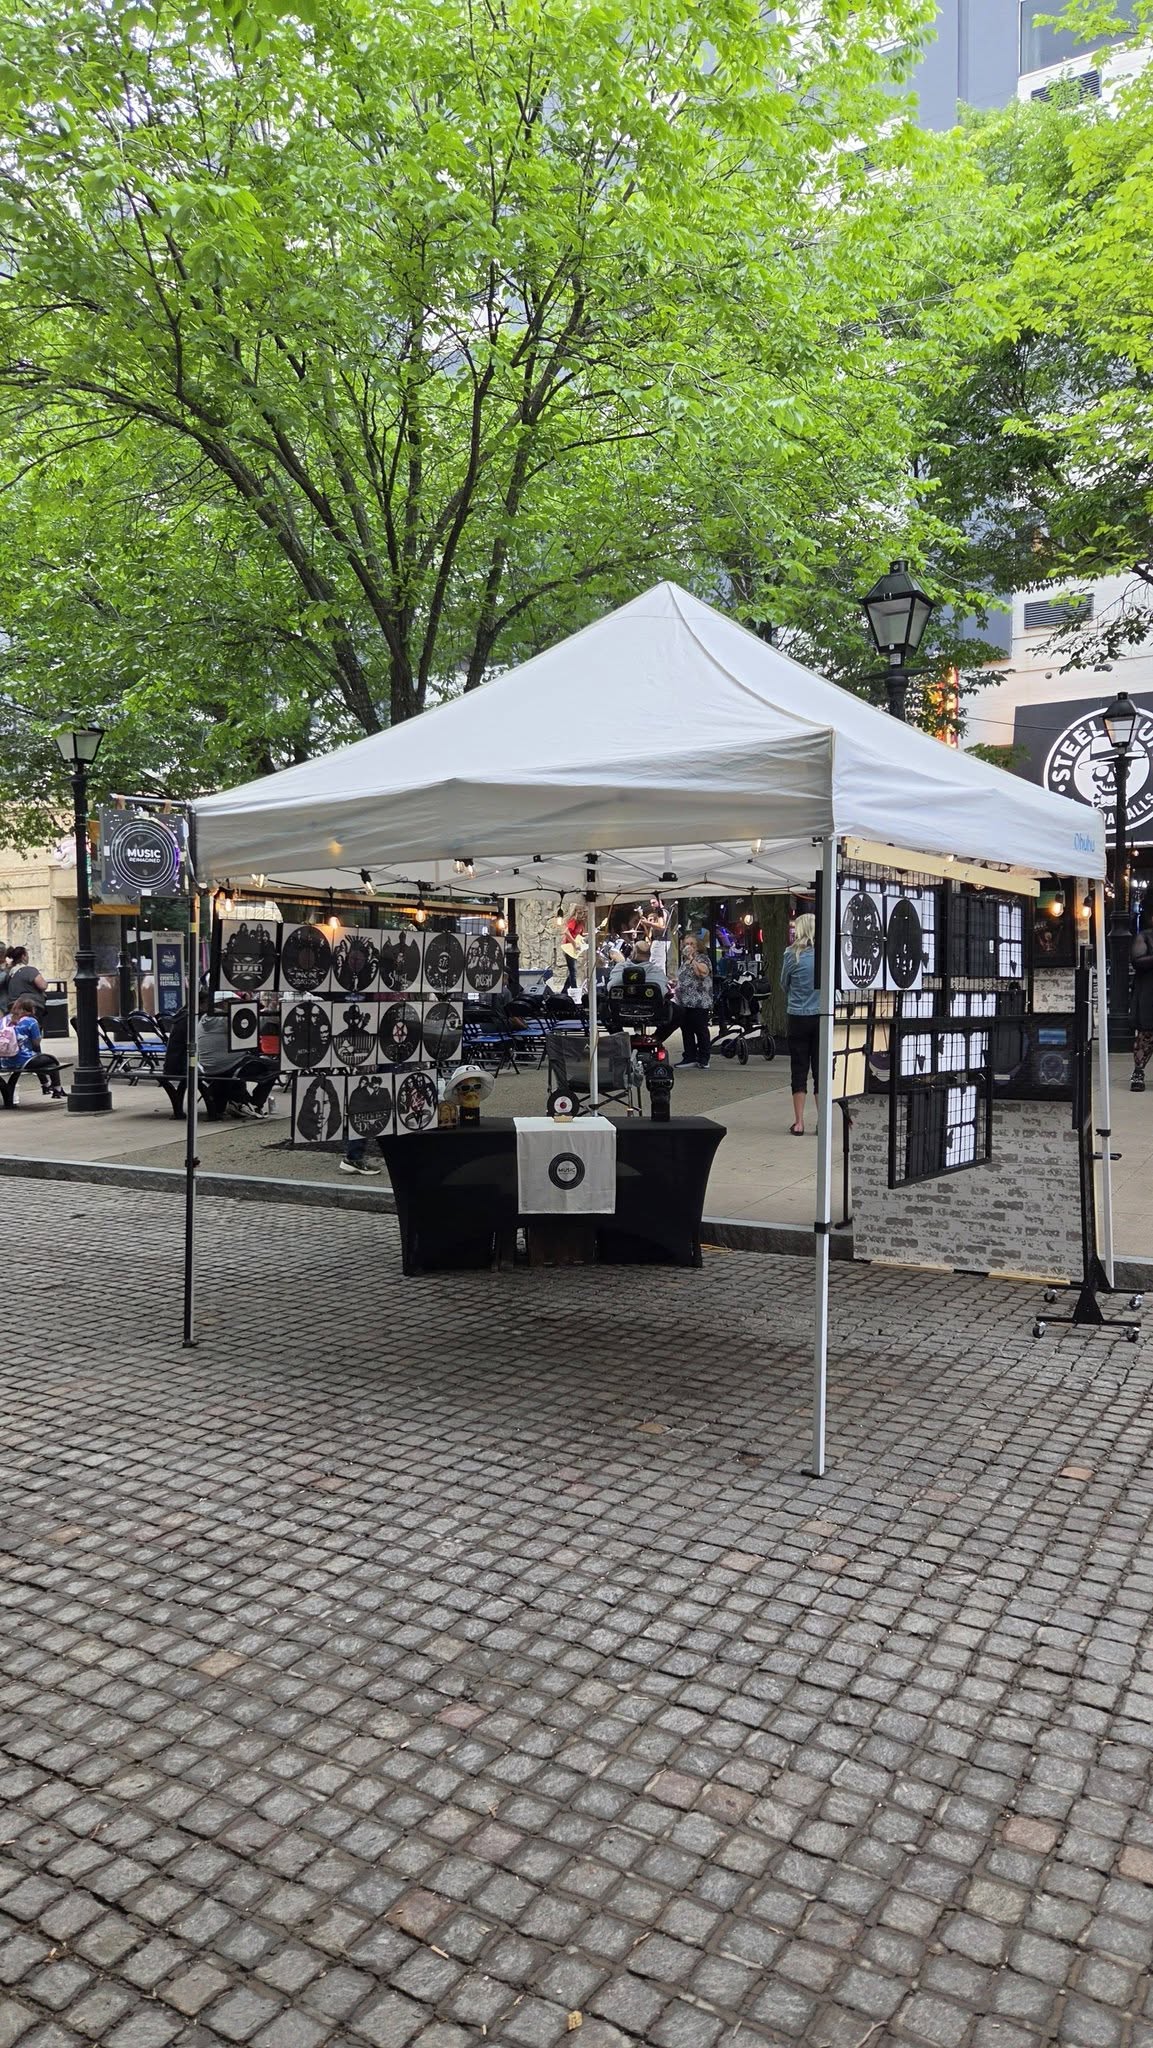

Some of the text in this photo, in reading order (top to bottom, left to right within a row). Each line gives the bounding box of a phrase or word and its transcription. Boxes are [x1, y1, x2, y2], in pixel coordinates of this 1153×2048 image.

[127, 848, 161, 858] MUSIC
[853, 958, 872, 976] KISS
[474, 973, 493, 988] RUSH
